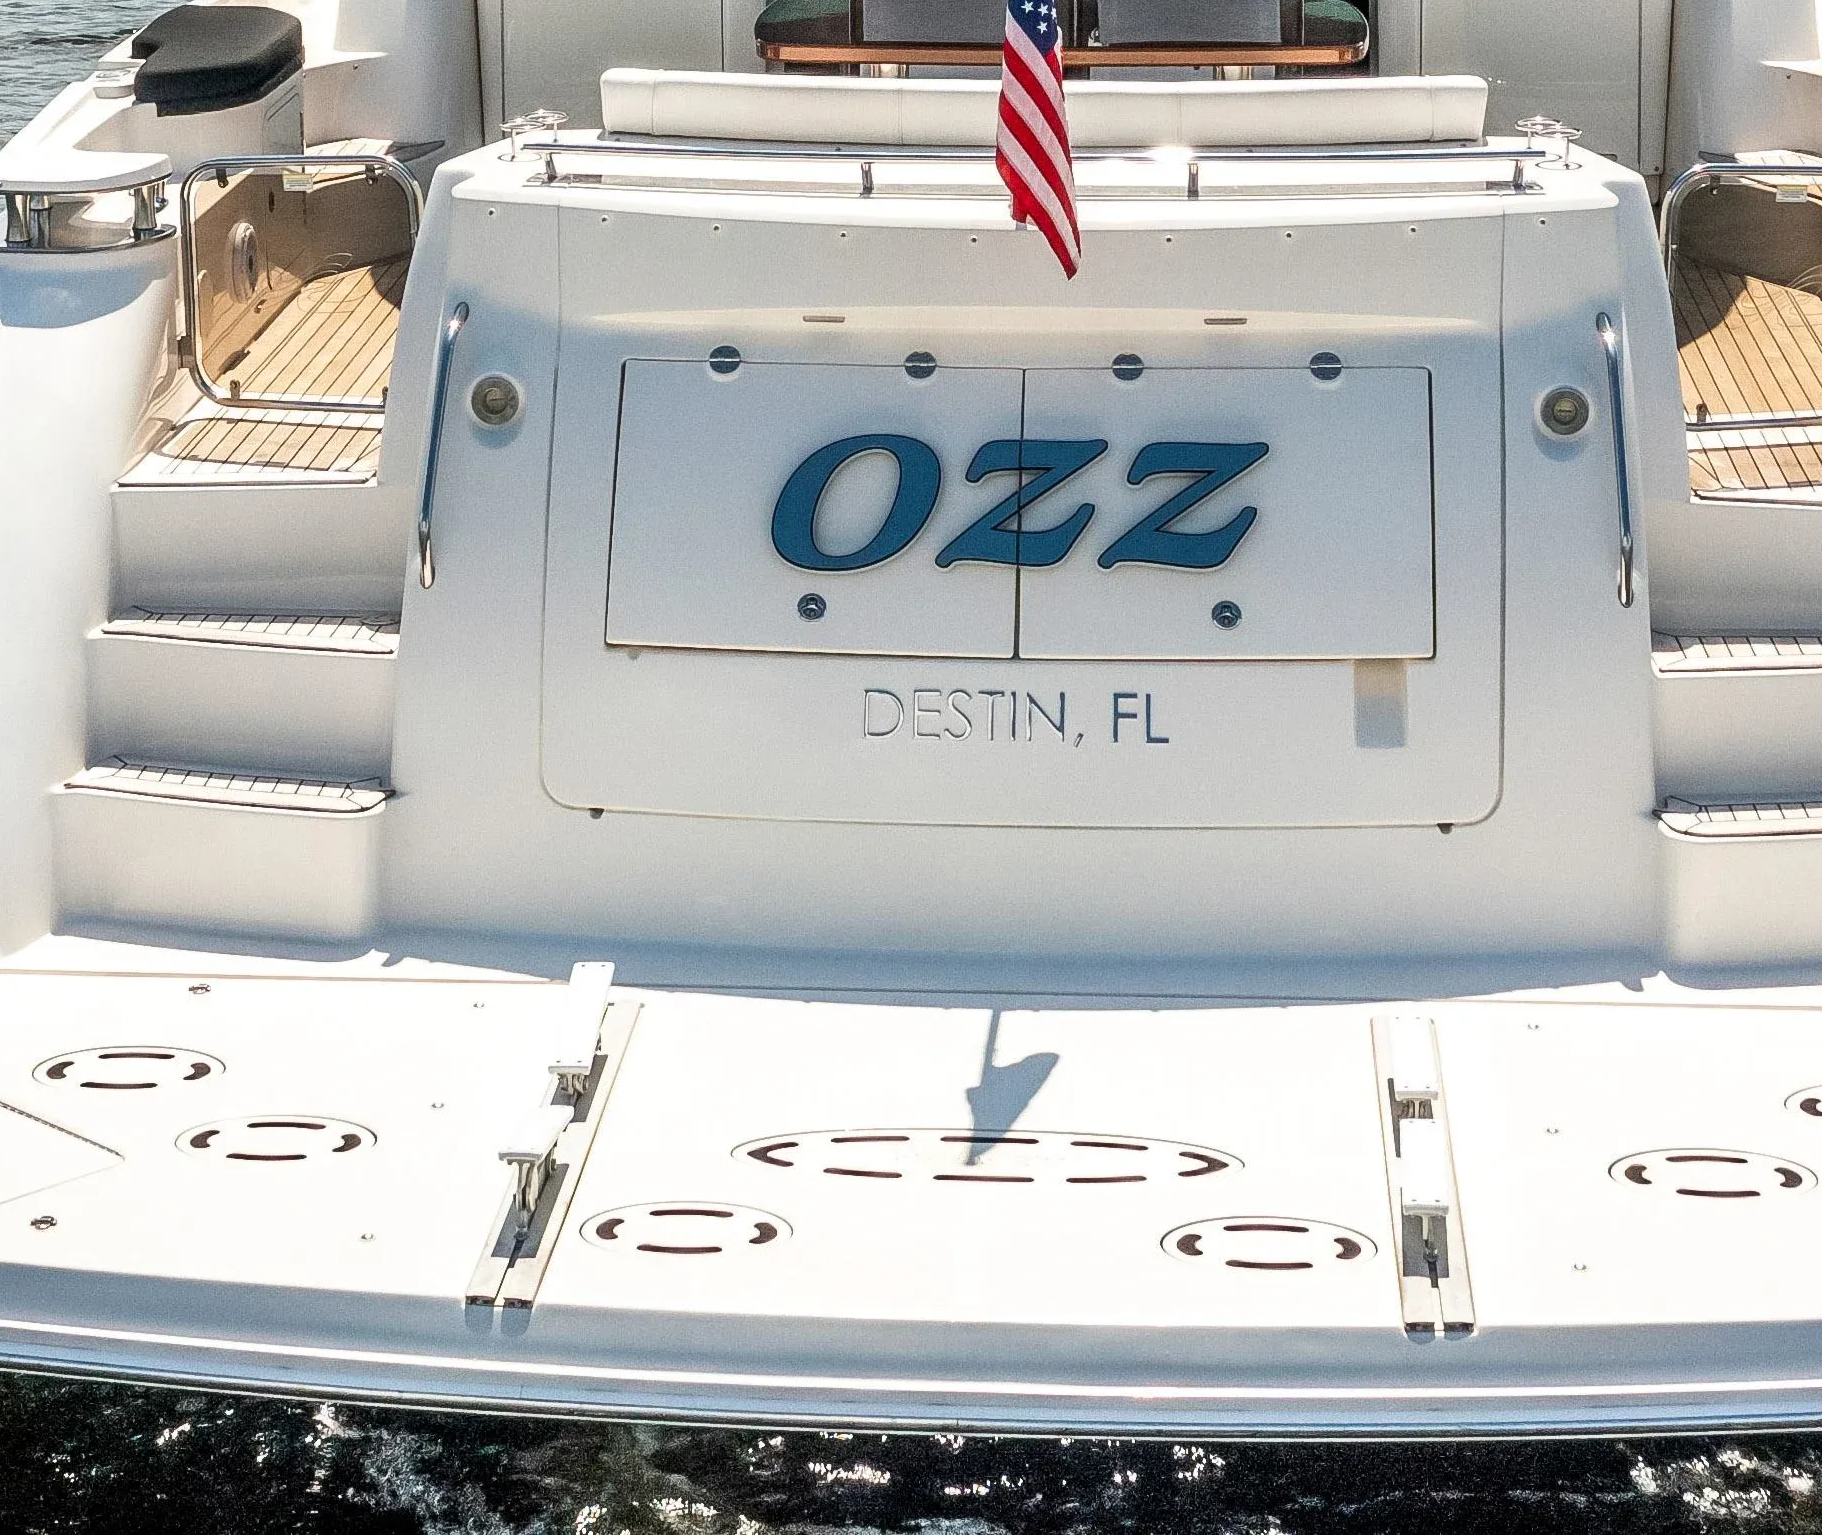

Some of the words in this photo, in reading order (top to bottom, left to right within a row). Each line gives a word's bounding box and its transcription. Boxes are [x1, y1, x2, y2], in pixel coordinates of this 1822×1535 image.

[771, 433, 1270, 573] OZZ
[862, 688, 1084, 748] DESTIN,
[1112, 692, 1171, 745] FL
